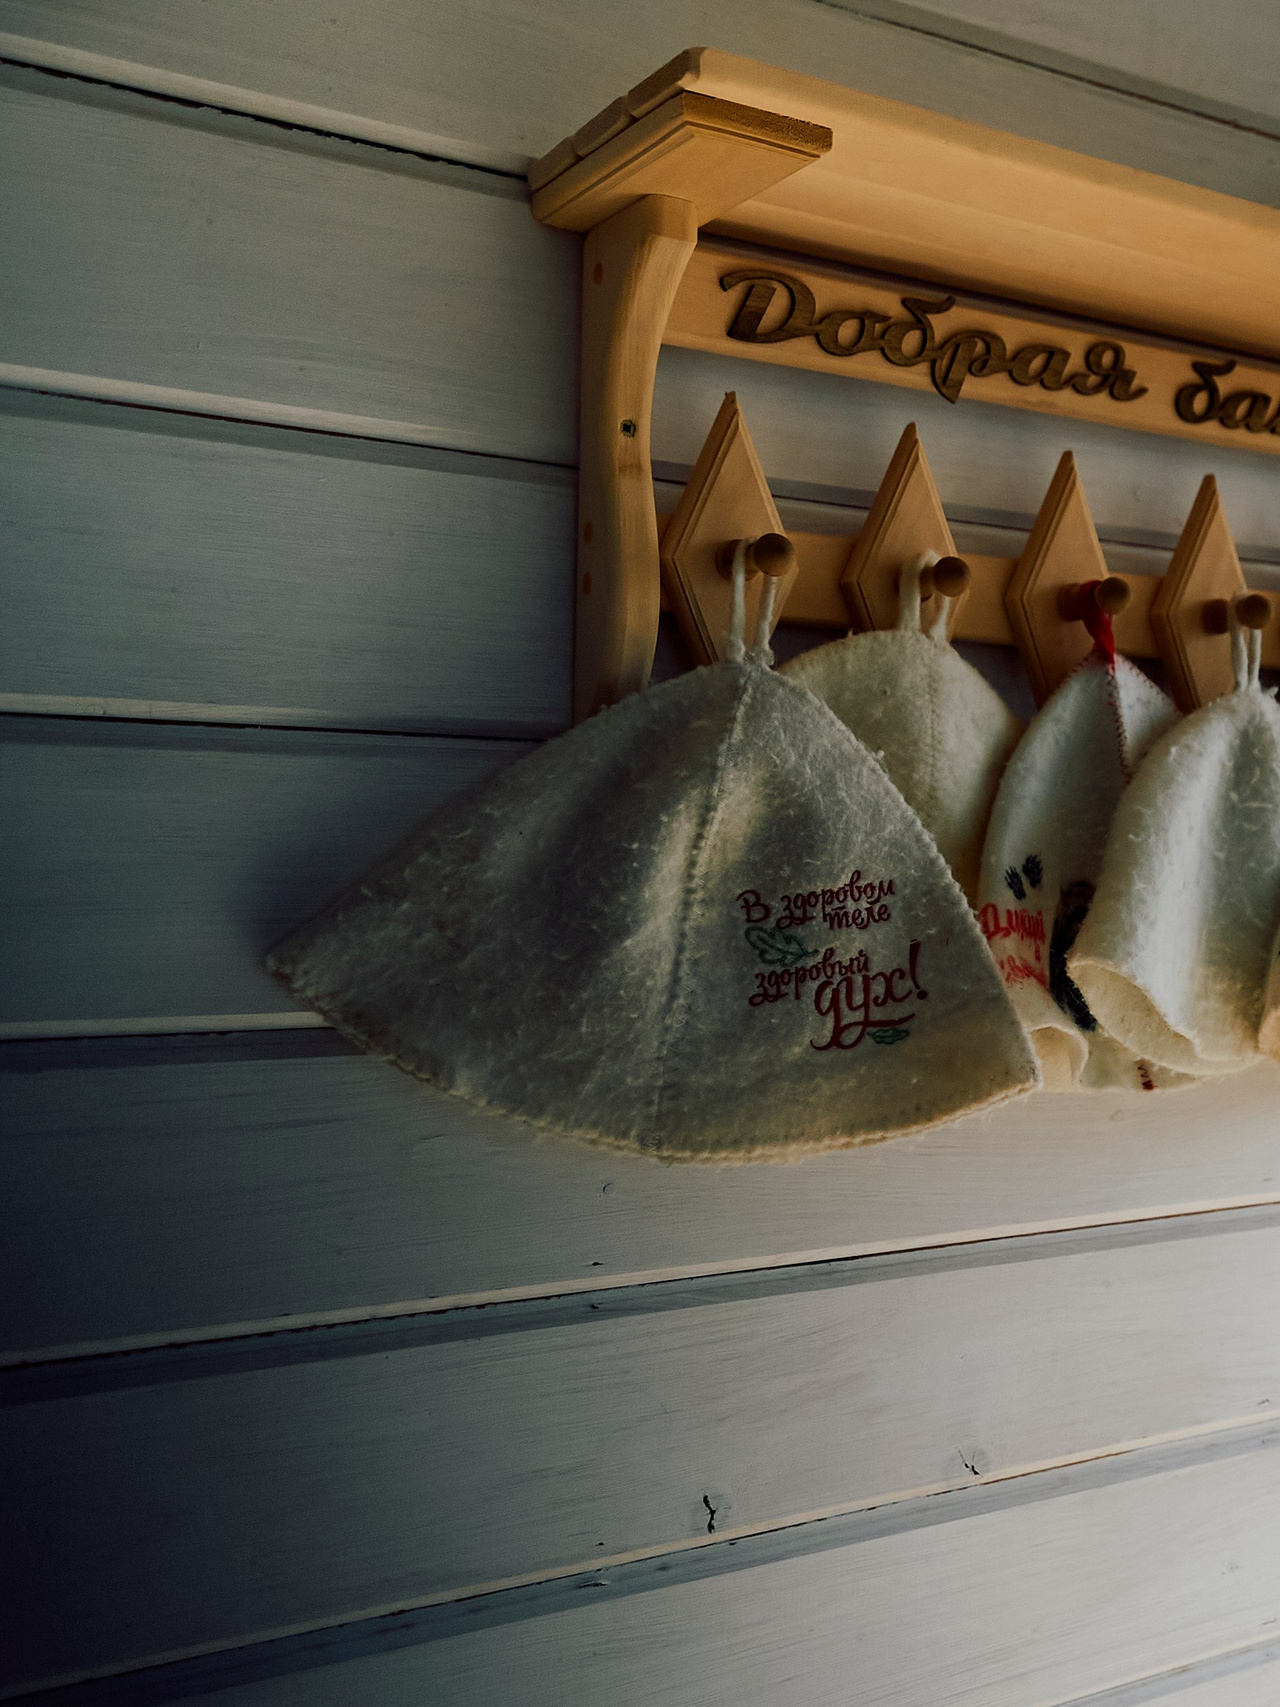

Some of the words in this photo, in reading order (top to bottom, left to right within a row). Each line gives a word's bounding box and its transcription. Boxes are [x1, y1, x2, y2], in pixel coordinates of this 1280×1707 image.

[718, 268, 1149, 404] Добрая
[736, 889, 771, 924] В
[775, 869, 896, 930] здоровом
[827, 902, 891, 931] теле
[748, 947, 870, 1007] здоровый
[809, 938, 929, 1050] дух!
